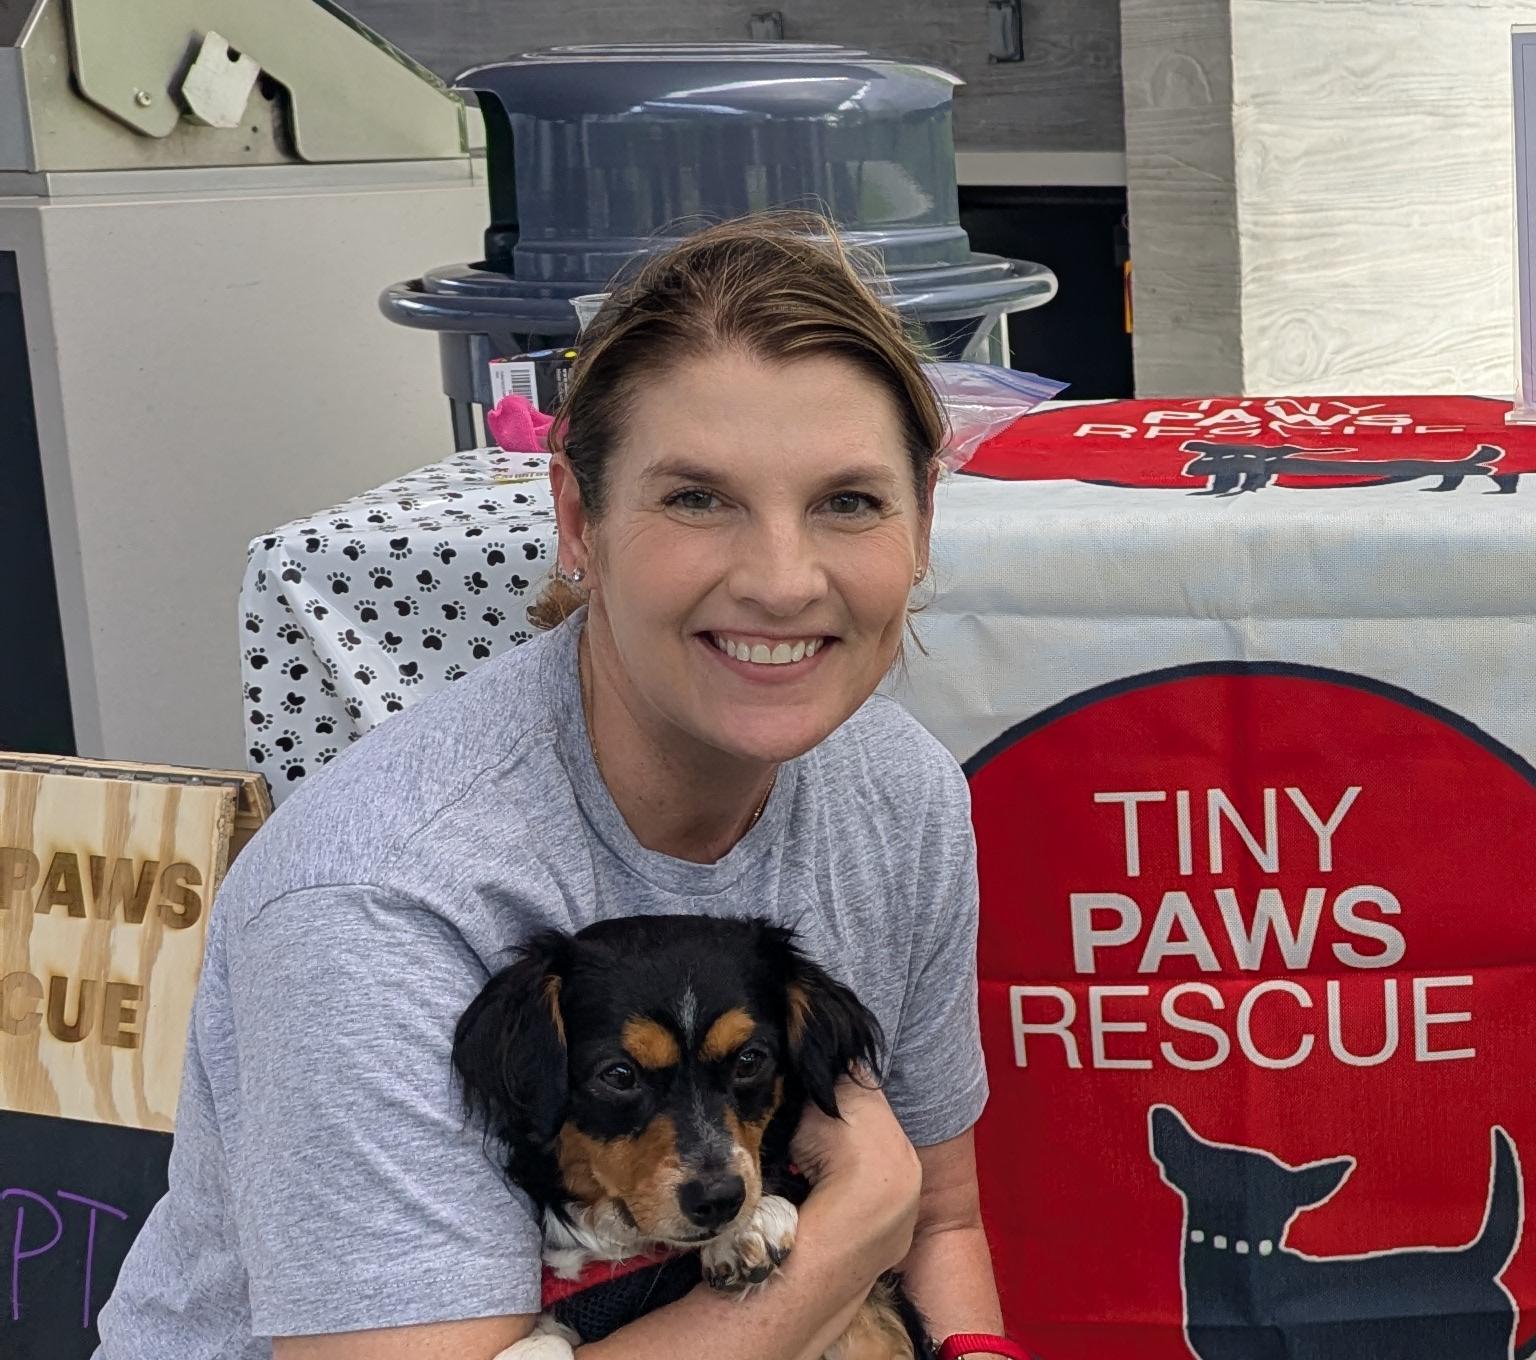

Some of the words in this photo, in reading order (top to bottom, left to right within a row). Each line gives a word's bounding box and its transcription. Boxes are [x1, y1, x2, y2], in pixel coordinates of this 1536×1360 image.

[1143, 409, 1413, 427] PAWS
[1182, 398, 1389, 415] TINY
[1093, 786, 1362, 878] TINY
[0, 846, 203, 930] PAWS
[1069, 885, 1406, 974] PAWS
[0, 971, 144, 1050] CUE
[1009, 975, 1476, 1071] RESCUE
